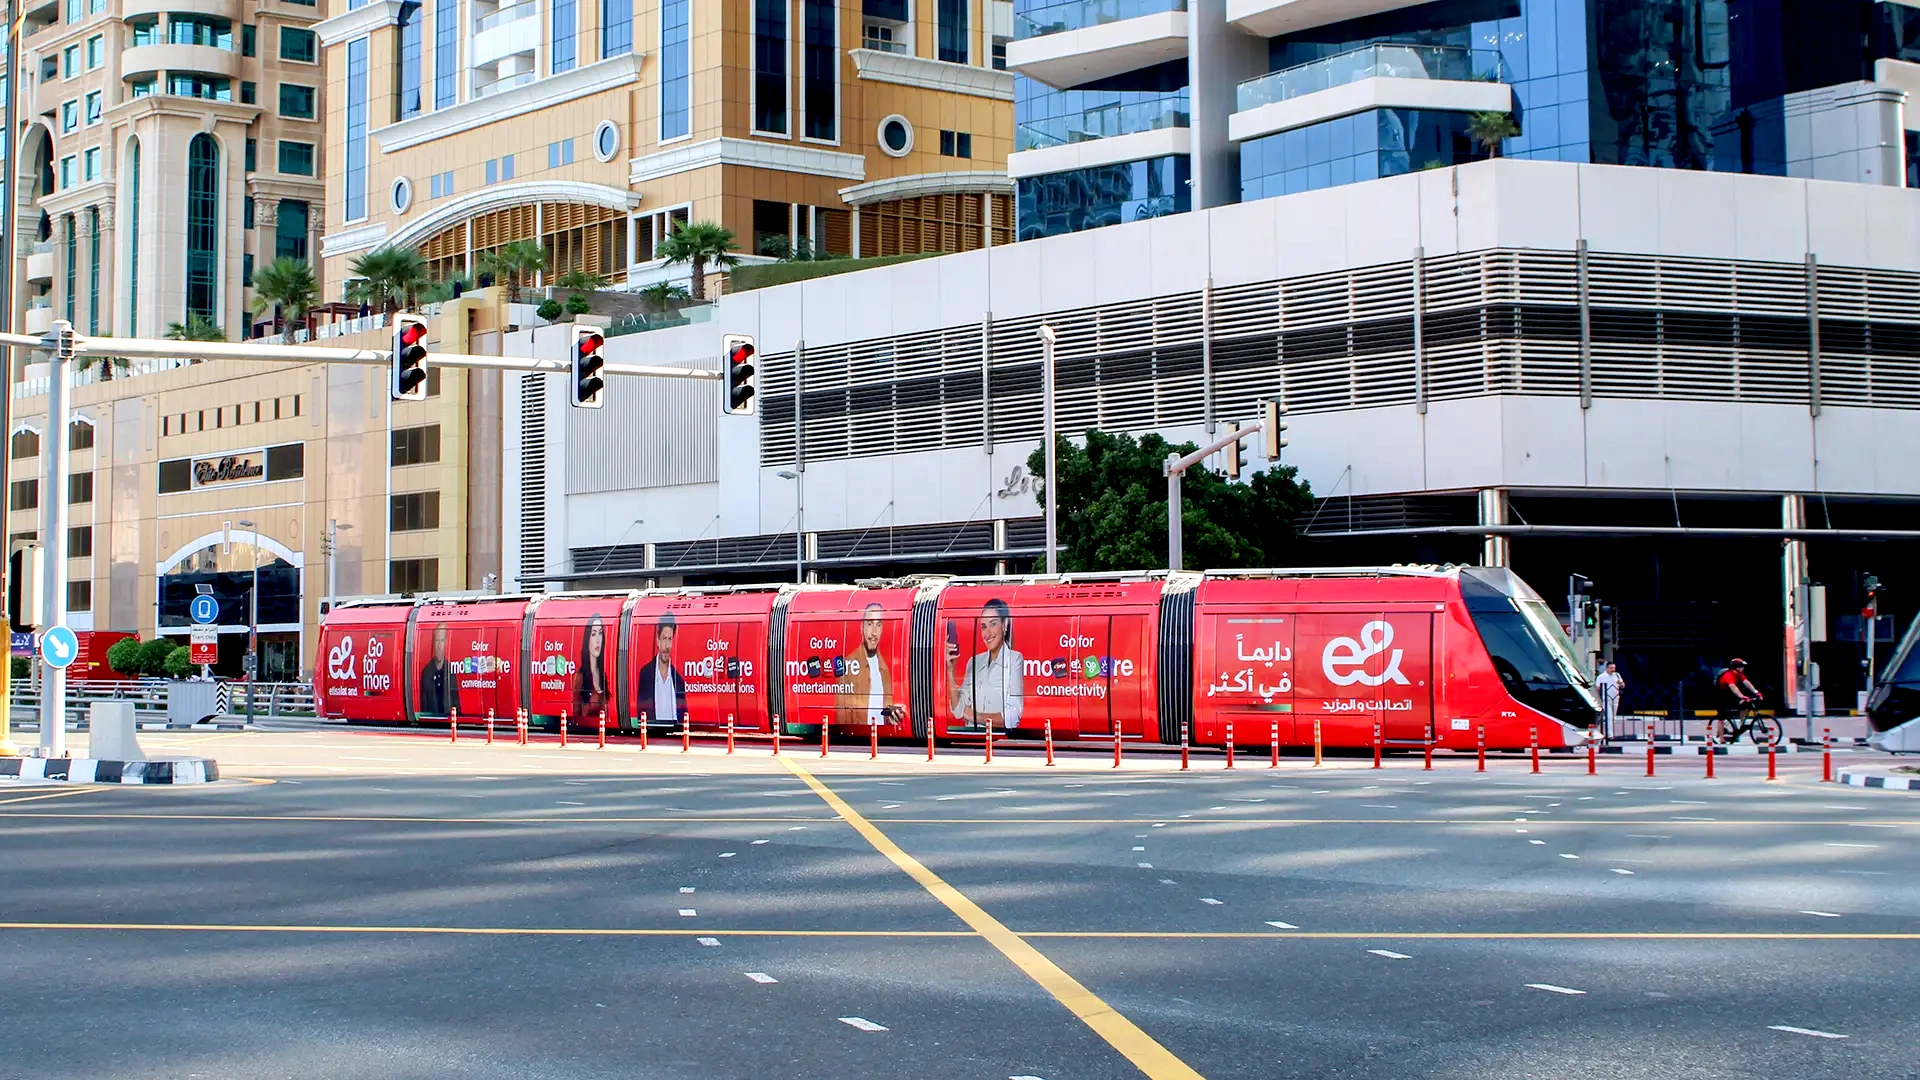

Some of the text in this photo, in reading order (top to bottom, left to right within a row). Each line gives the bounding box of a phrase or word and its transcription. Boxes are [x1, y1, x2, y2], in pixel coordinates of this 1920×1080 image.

[368, 637, 384, 657] Go
[471, 640, 489, 651] Go for
[544, 640, 564, 651] Go for
[706, 638, 730, 651] Go for
[809, 636, 838, 650] Go for
[1059, 634, 1095, 648] Go for
[328, 635, 357, 680] e&
[1322, 620, 1411, 686] e&
[363, 654, 378, 674] for
[363, 674, 390, 690] more
[461, 679, 497, 689] convenience
[541, 679, 566, 692] mobility
[684, 681, 717, 693] business
[792, 681, 855, 694] entertainment
[1206, 668, 1292, 704] في أكثر
[1036, 683, 1107, 699] connectivity
[1365, 699, 1412, 711] اتصالات
[1501, 710, 1517, 718] RTA
